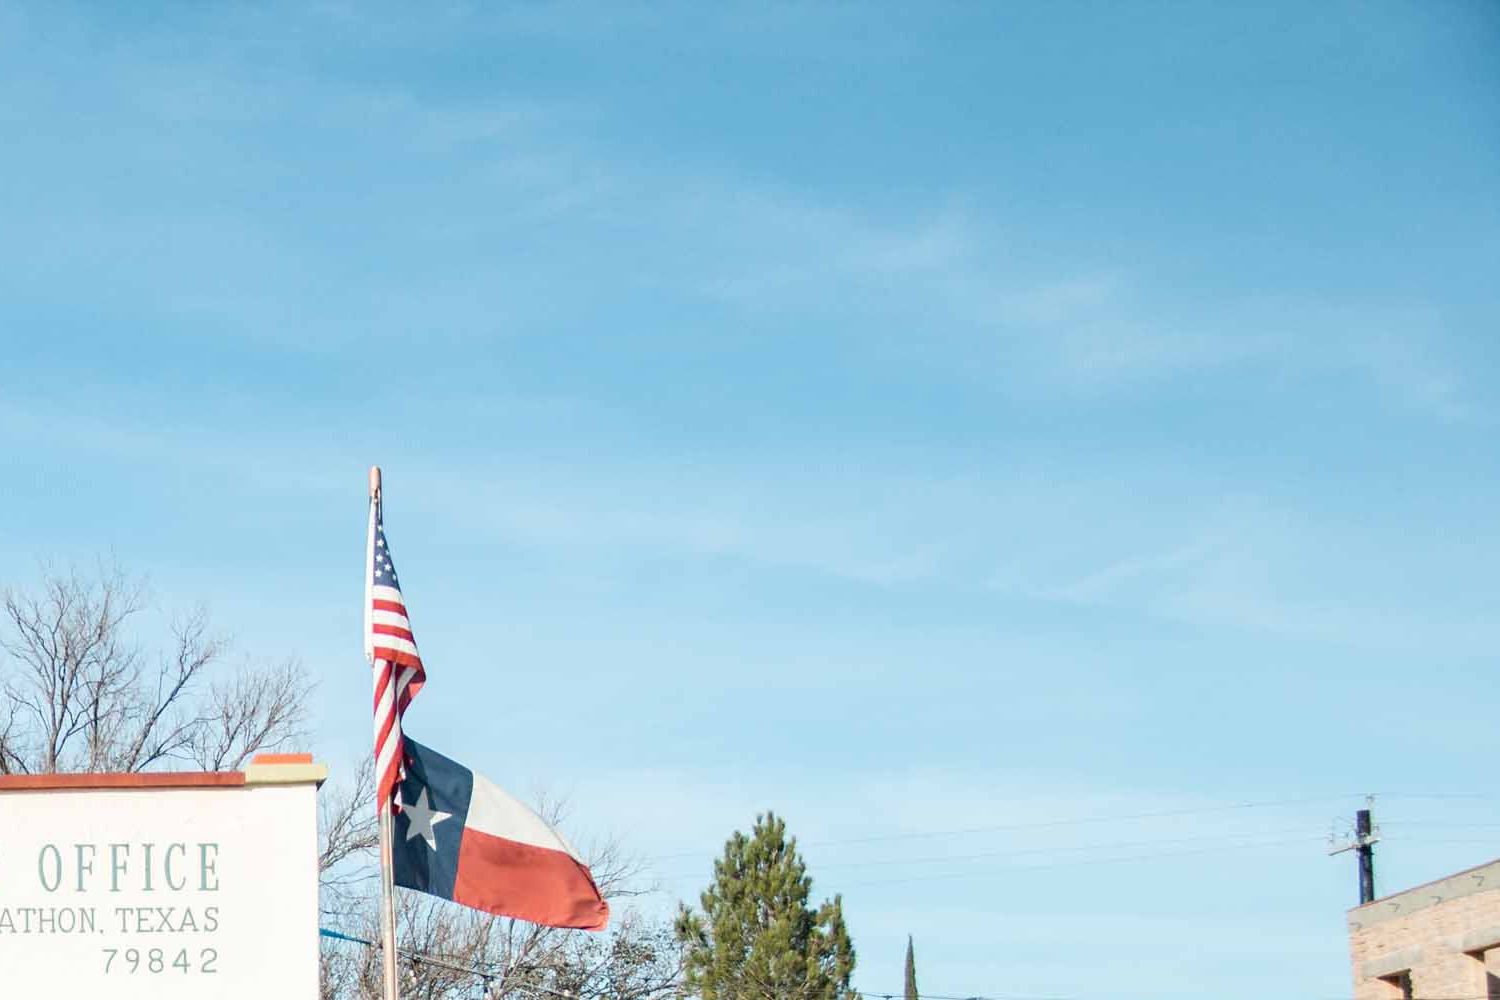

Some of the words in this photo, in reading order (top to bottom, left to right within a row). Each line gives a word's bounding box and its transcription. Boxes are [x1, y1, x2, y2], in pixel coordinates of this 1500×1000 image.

[38, 842, 220, 893] OFFICE
[114, 906, 220, 934] TEXAS
[102, 947, 218, 975] 79842
